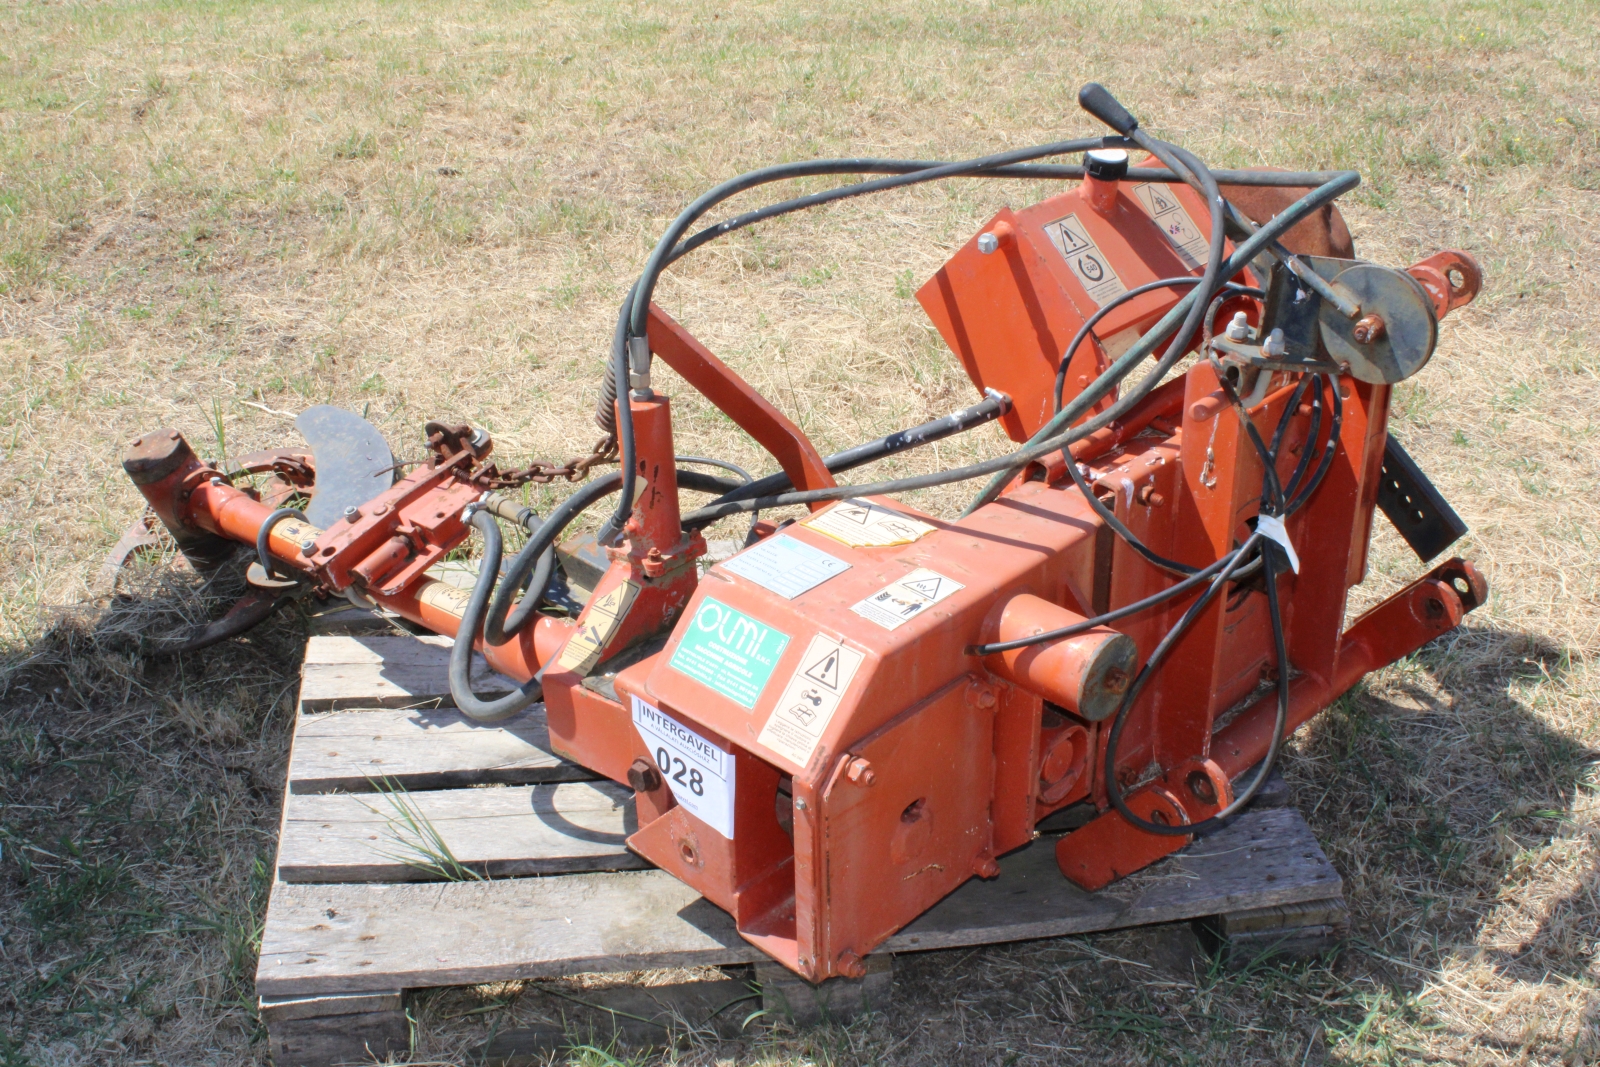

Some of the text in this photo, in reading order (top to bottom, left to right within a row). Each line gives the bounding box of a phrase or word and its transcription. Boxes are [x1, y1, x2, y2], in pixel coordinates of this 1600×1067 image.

[697, 603, 769, 658] OLMI
[642, 705, 718, 762] INTERGAVEL
[656, 746, 704, 797] 028
